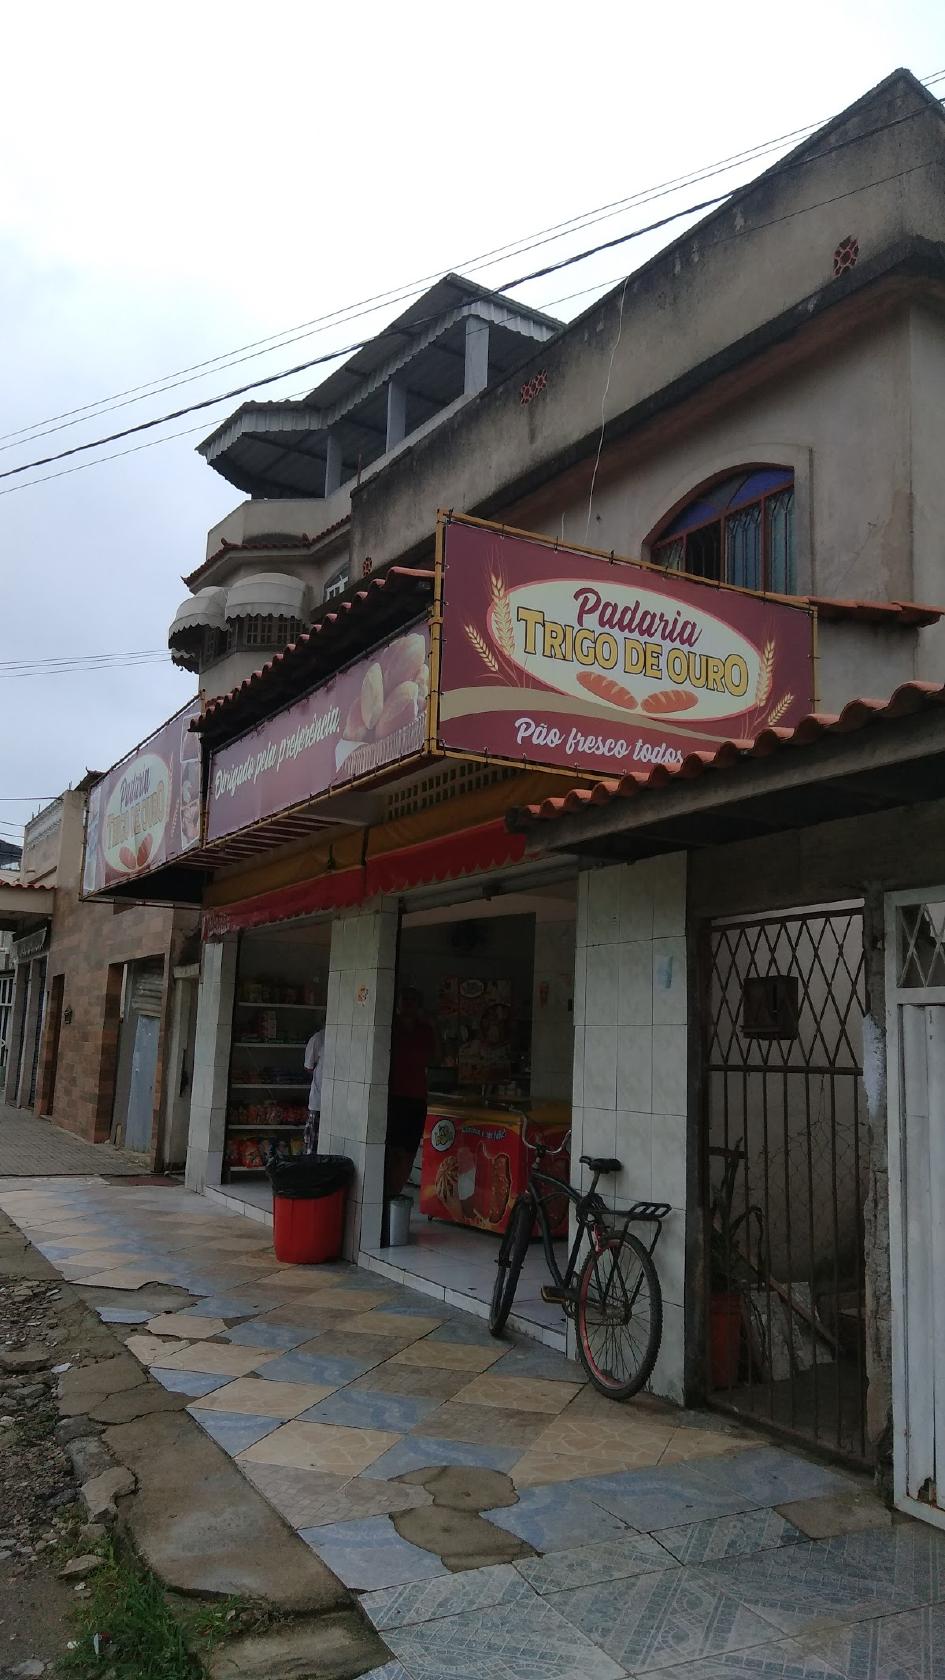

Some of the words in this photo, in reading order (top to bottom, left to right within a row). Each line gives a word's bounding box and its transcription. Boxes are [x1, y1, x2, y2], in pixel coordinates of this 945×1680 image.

[573, 587, 702, 647] Padaria
[517, 606, 619, 670] TRIGO
[623, 636, 664, 680] DE
[666, 648, 749, 697] OURO
[253, 741, 277, 784] pela
[514, 717, 566, 747] Pão
[565, 728, 630, 756] fresco
[632, 738, 684, 764] todos
